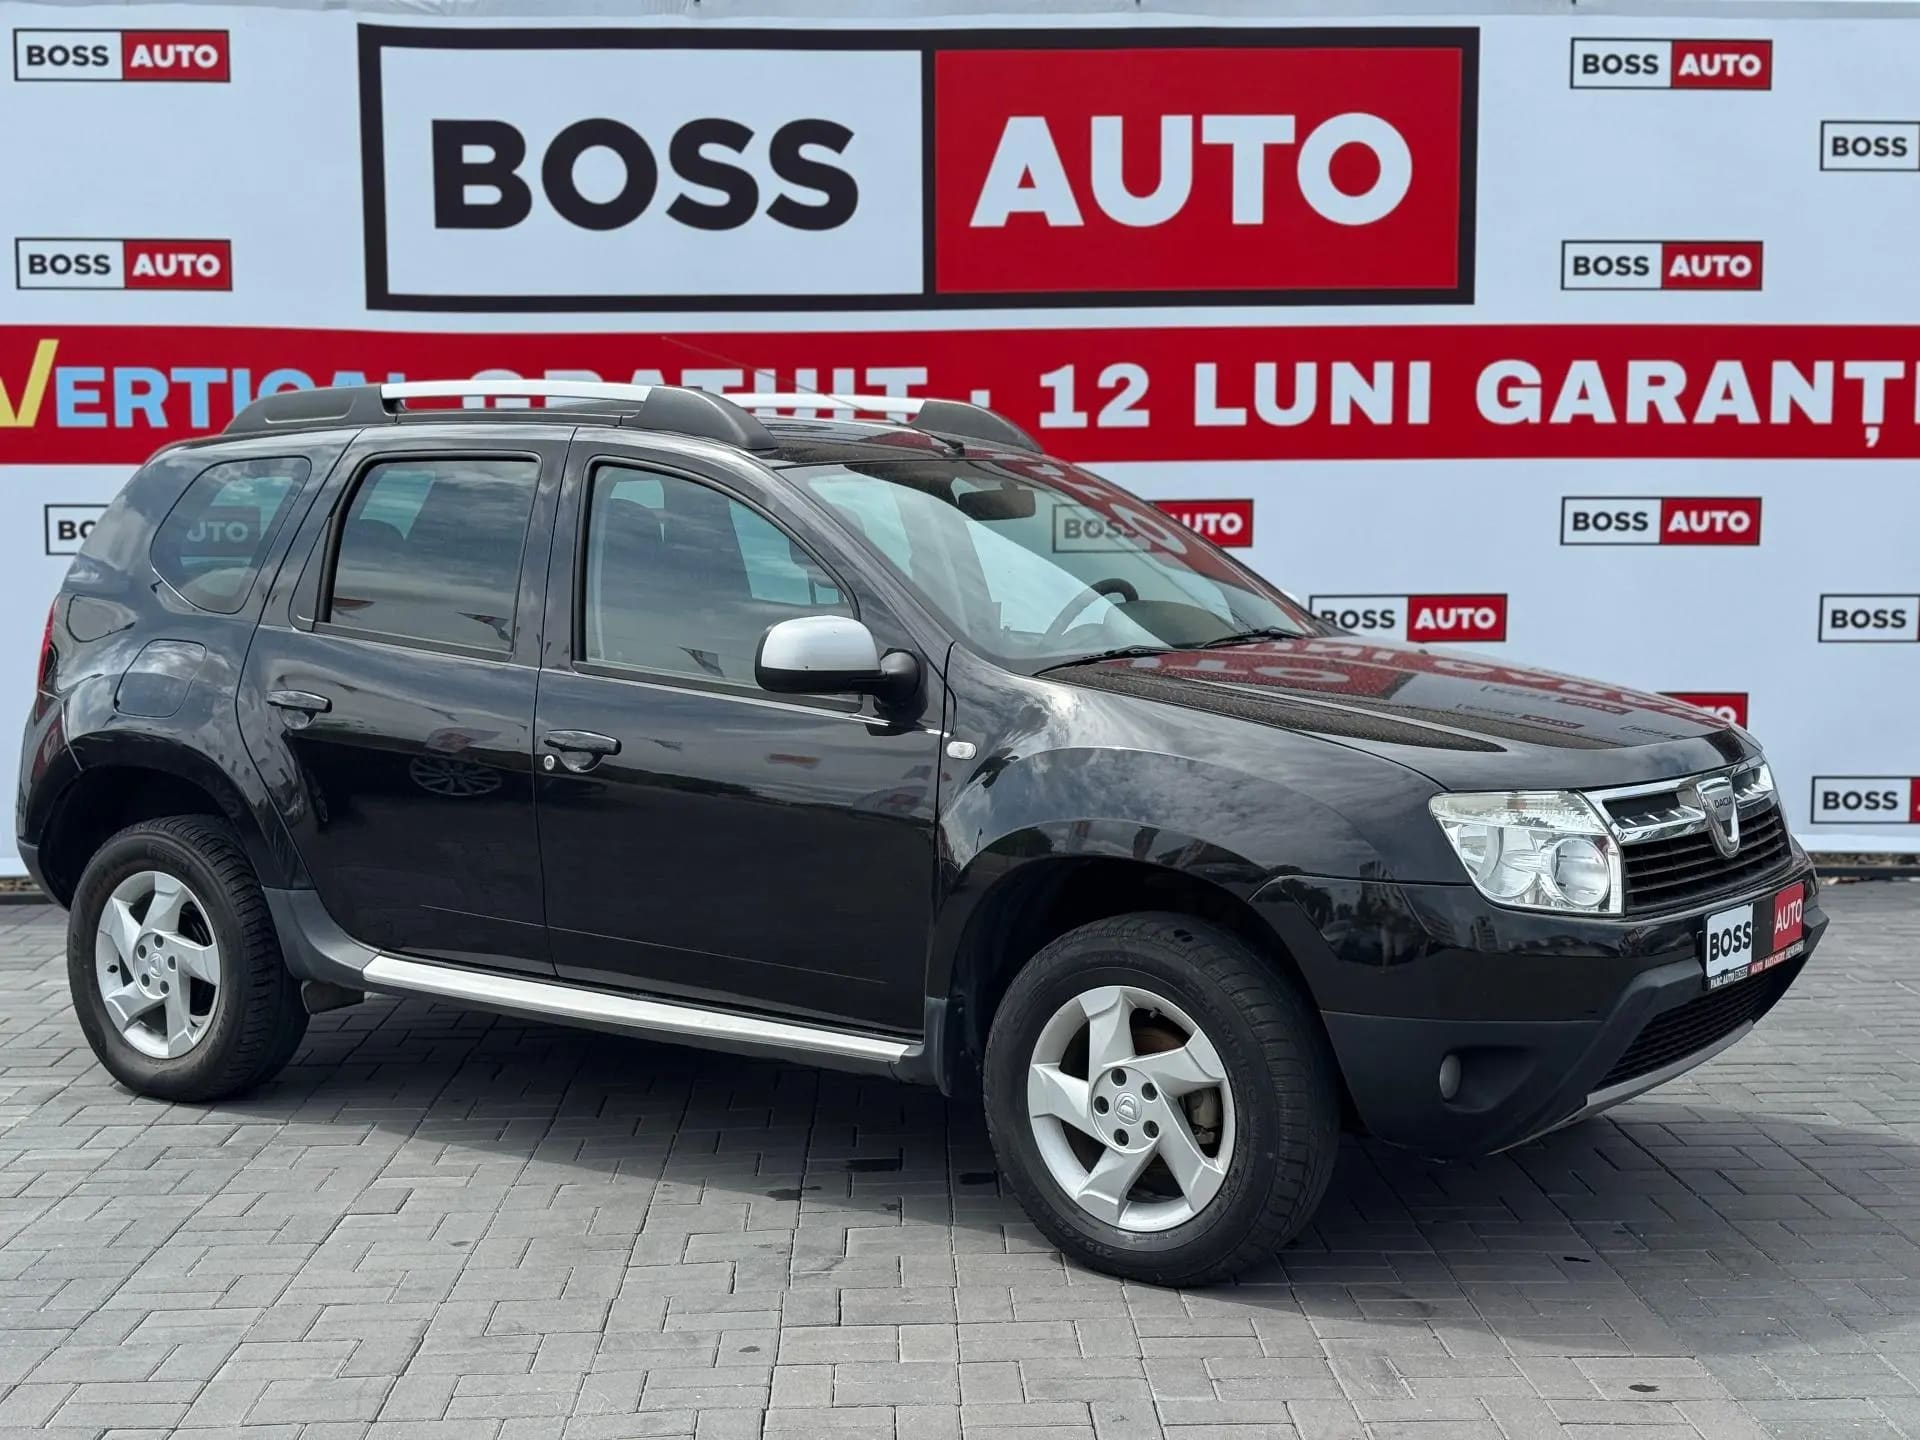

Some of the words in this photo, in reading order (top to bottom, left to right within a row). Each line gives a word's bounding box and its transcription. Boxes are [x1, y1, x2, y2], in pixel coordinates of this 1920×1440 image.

[27, 45, 109, 67] BOSS
[131, 45, 219, 68] AUTO
[1582, 53, 1659, 75] BOSS
[1679, 54, 1762, 76] AUTO
[1832, 136, 1907, 157] BOSS
[432, 118, 858, 231] BOSS
[969, 113, 1412, 227] AUTO
[28, 254, 111, 275] BOSS
[133, 254, 221, 276] AUTO
[1573, 255, 1650, 276] BOSS
[1669, 255, 1752, 277] AUTO
[1040, 363, 1149, 428] 12
[1195, 362, 1430, 426] LUNI
[1476, 360, 1920, 447] GARANȚ
[186, 520, 249, 542] UTO
[1171, 512, 1243, 536] UTO
[1573, 511, 1649, 532] BOSS
[1668, 511, 1750, 533] AUTO
[1415, 607, 1497, 630] AUTO
[1831, 609, 1907, 629] BOSS
[1822, 791, 1898, 811] BOSS
[1709, 921, 1752, 961] BOSS
[1774, 898, 1803, 935] AUTO
